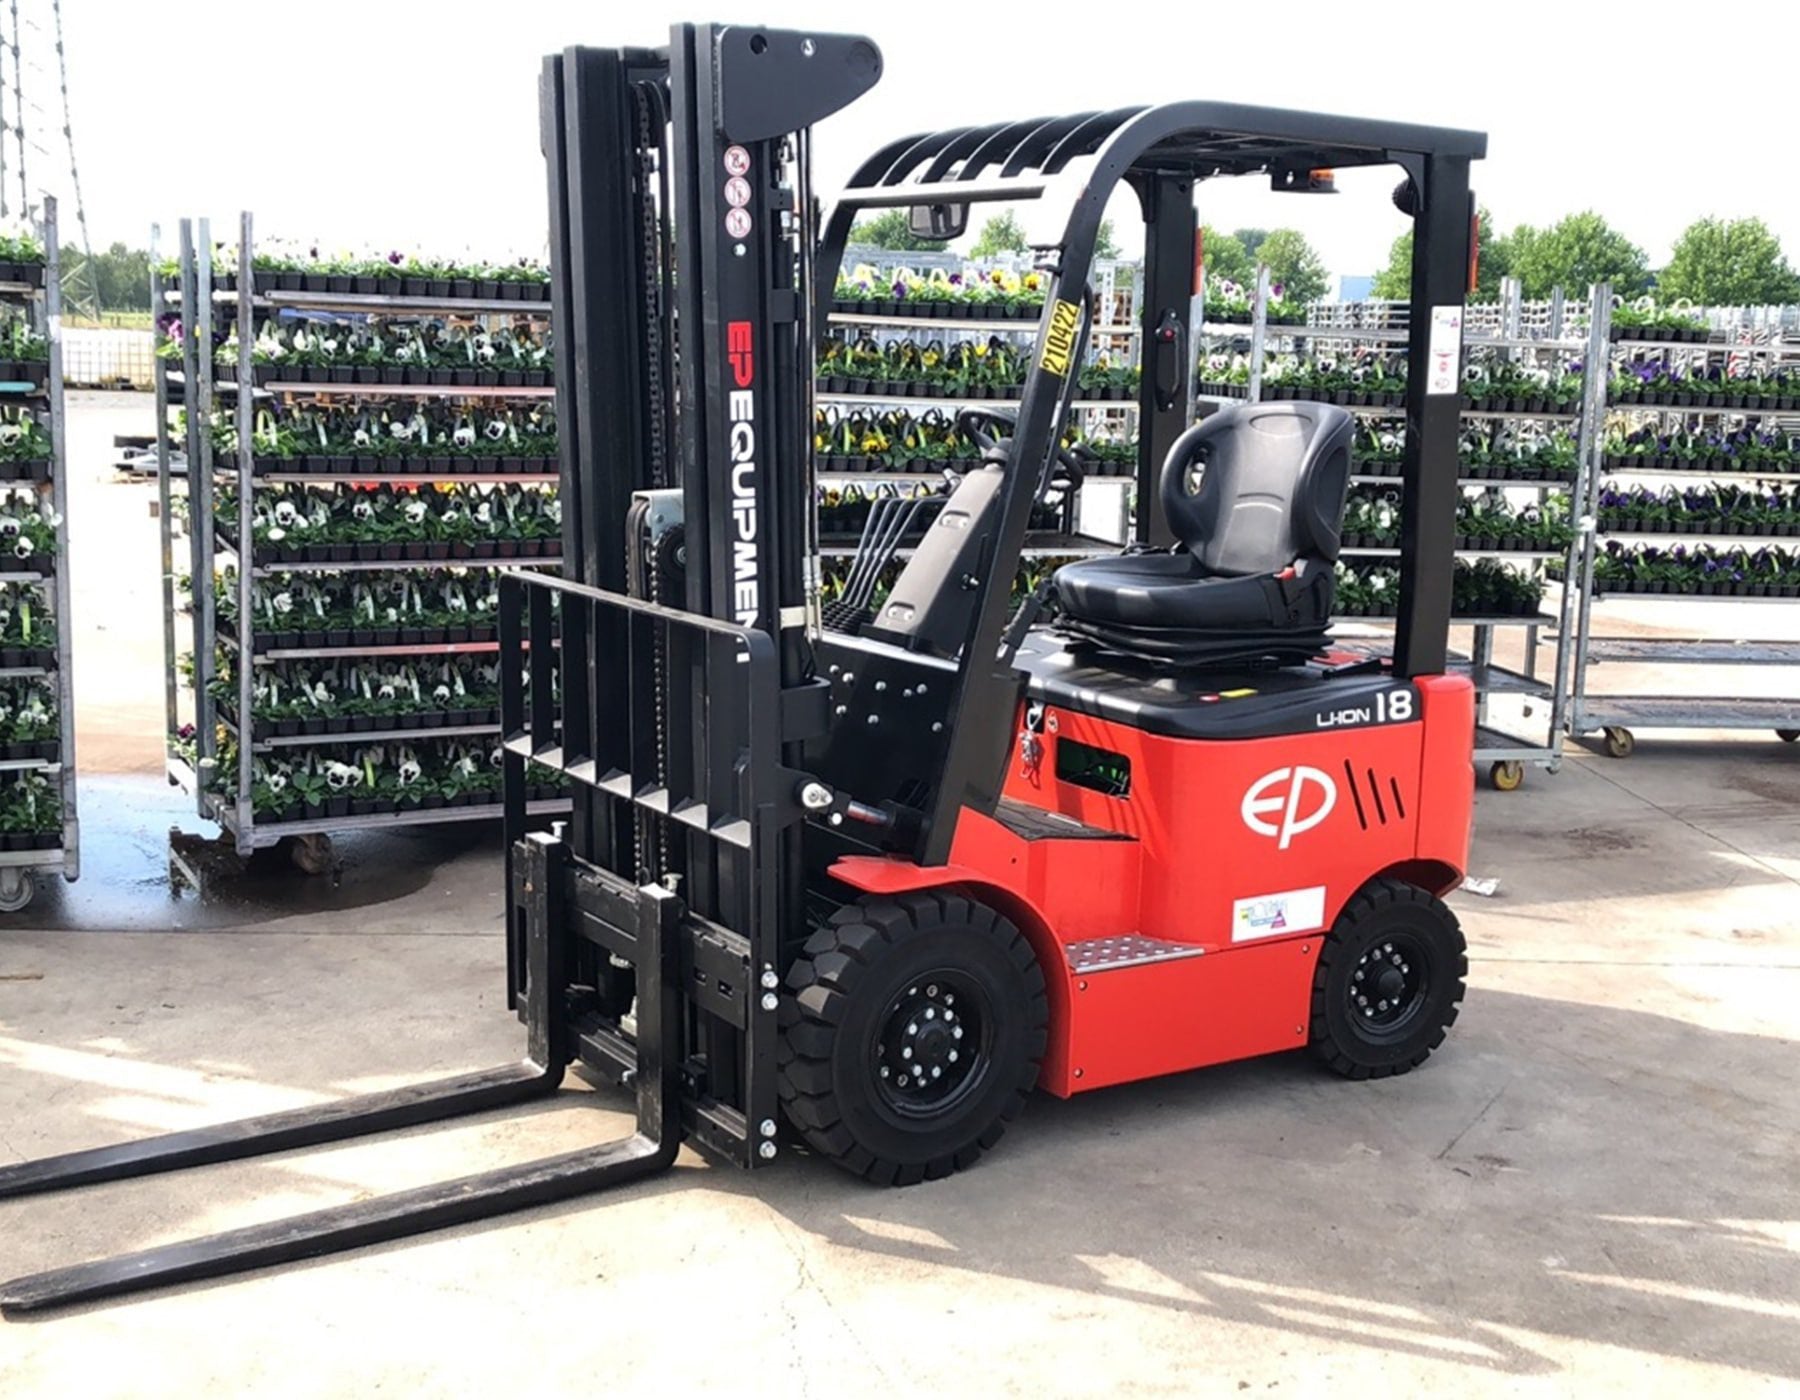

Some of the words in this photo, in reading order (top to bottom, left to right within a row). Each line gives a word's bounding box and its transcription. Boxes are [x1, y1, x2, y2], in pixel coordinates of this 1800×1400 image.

[727, 321, 753, 389] EP
[1042, 301, 1078, 374] 210422
[1376, 689, 1413, 723] 18
[1241, 765, 1337, 850] EP
